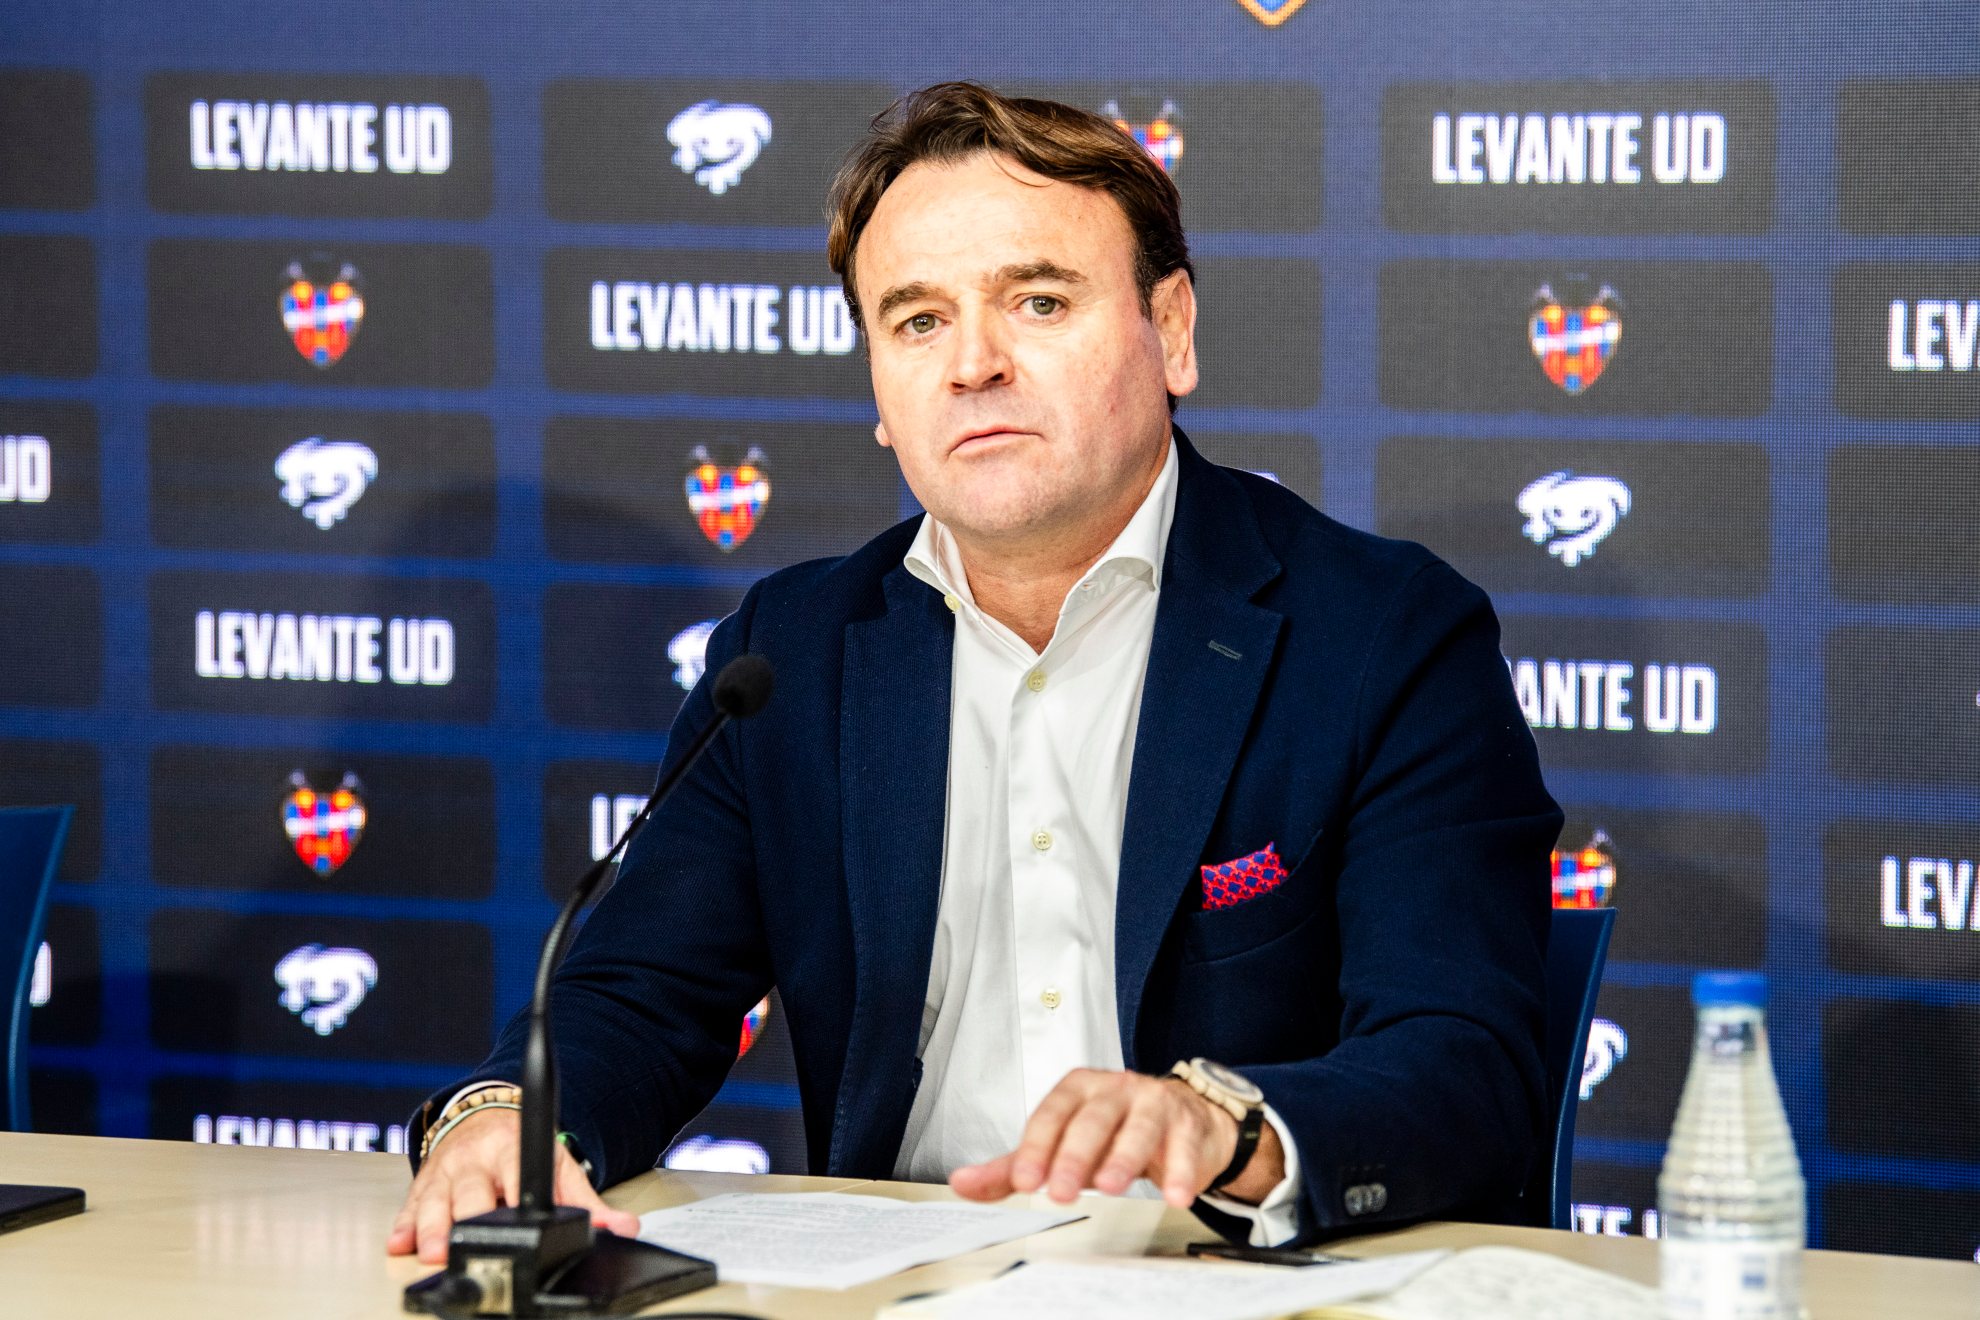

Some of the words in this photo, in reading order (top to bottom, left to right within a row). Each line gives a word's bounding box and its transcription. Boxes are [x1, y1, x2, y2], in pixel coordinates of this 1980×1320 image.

[190, 100, 379, 173] LEVANTE
[385, 104, 452, 175] UD
[1432, 112, 1642, 184] LEVANTE
[1652, 112, 1728, 184] UD
[591, 281, 780, 354] LEVANTE
[788, 286, 855, 355] UD
[1888, 299, 1980, 372] LEV
[195, 610, 383, 683] LEVANTE
[388, 617, 455, 686] UD
[1505, 657, 1634, 731] ANTE
[1644, 662, 1719, 734] UD
